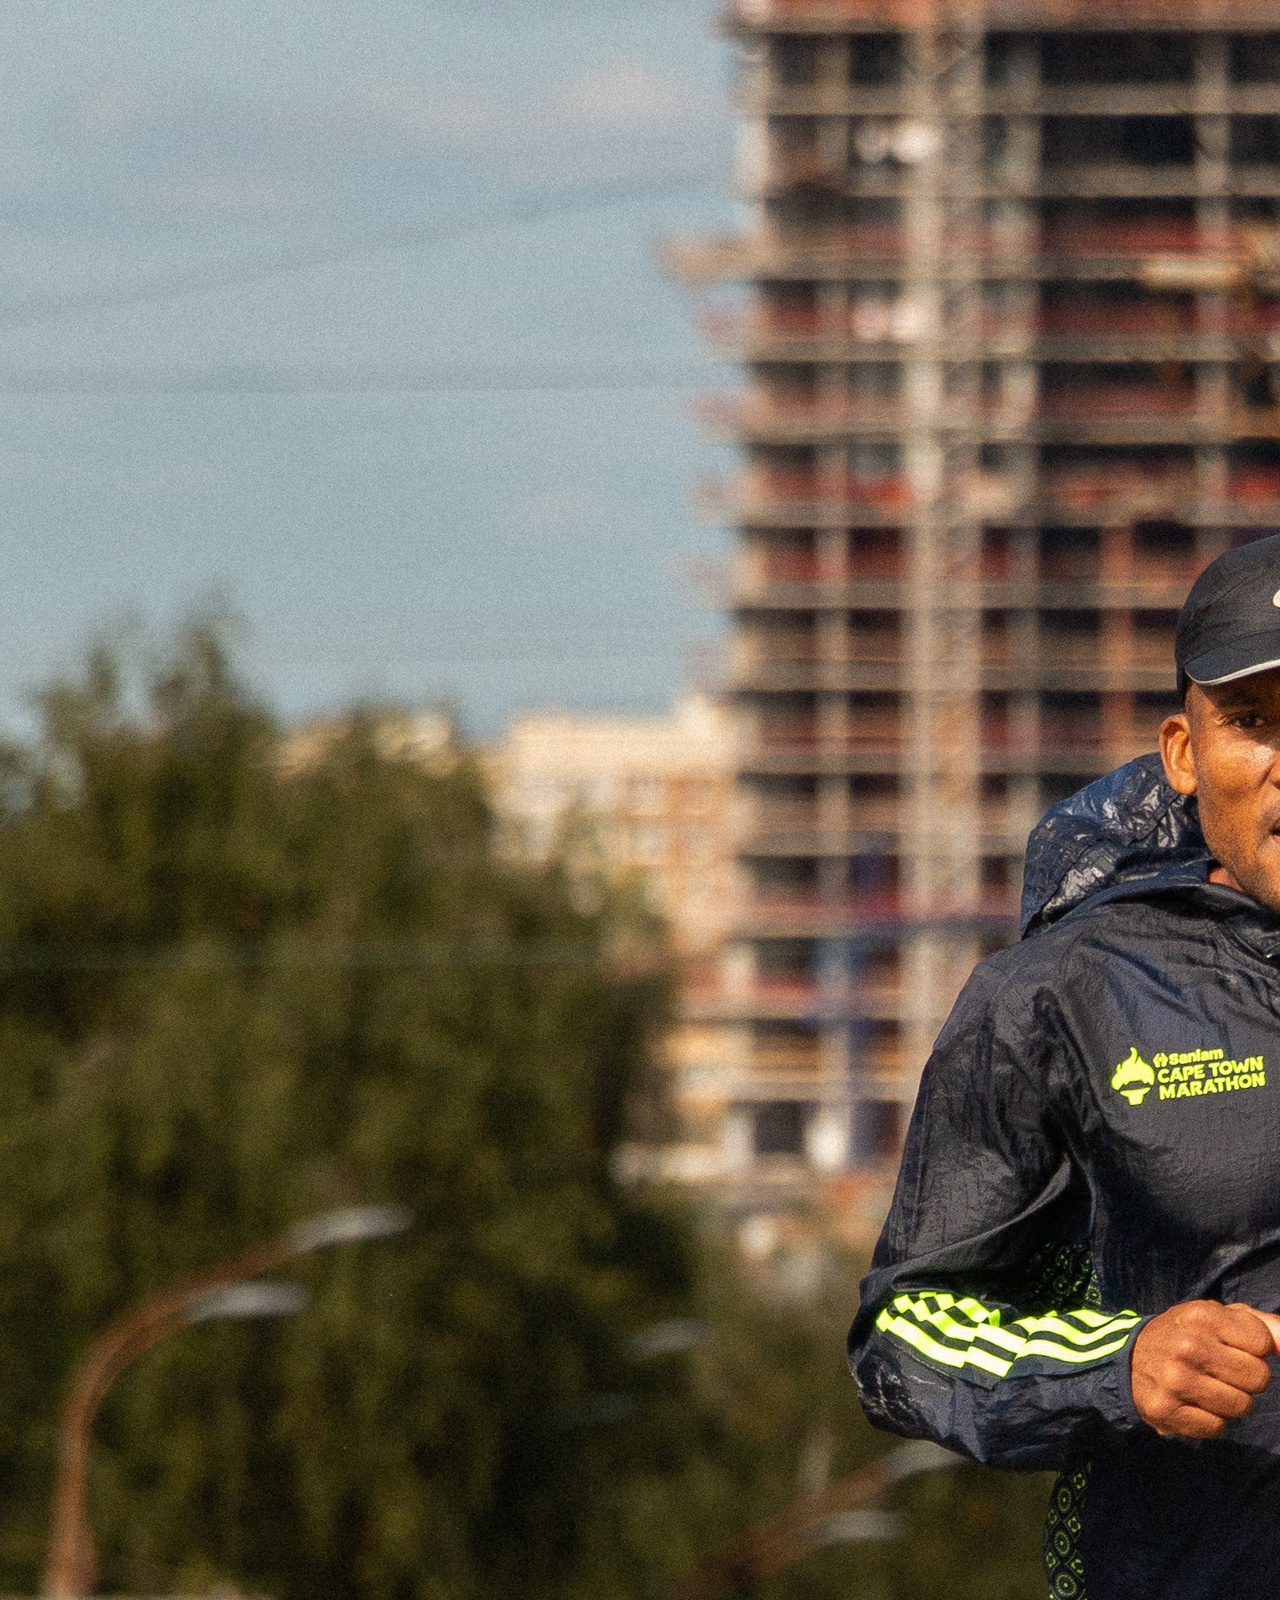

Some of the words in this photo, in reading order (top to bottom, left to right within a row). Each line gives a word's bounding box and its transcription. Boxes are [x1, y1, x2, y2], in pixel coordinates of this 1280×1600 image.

[1157, 1063, 1205, 1083] CAPE
[1208, 1056, 1264, 1078] TOWN
[1168, 1048, 1224, 1066] Sanlam
[1158, 1072, 1266, 1100] MARATHON
